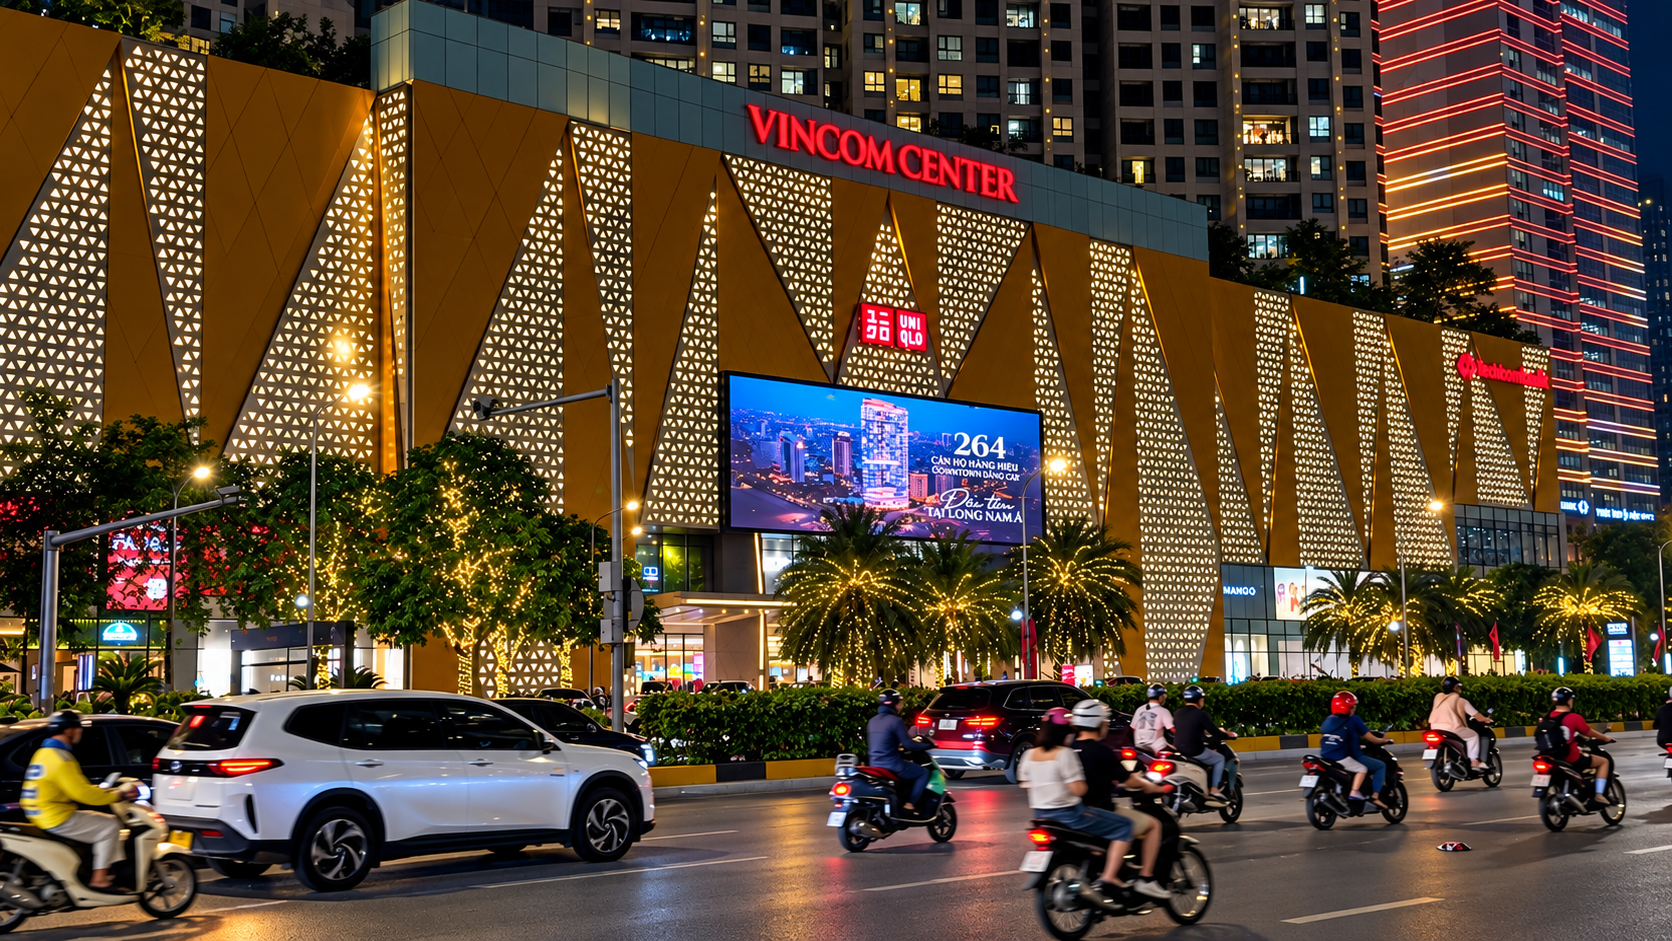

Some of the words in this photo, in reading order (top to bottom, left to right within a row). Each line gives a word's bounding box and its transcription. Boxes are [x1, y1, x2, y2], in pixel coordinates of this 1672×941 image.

[746, 104, 896, 174] VINCOM
[898, 144, 1019, 203] CENTER
[899, 314, 921, 331] UNI
[900, 329, 923, 348] QLO
[954, 432, 1006, 459] 264
[949, 509, 983, 520] LONG
[985, 512, 1013, 523] NAM
[1223, 586, 1256, 596] MANGO
